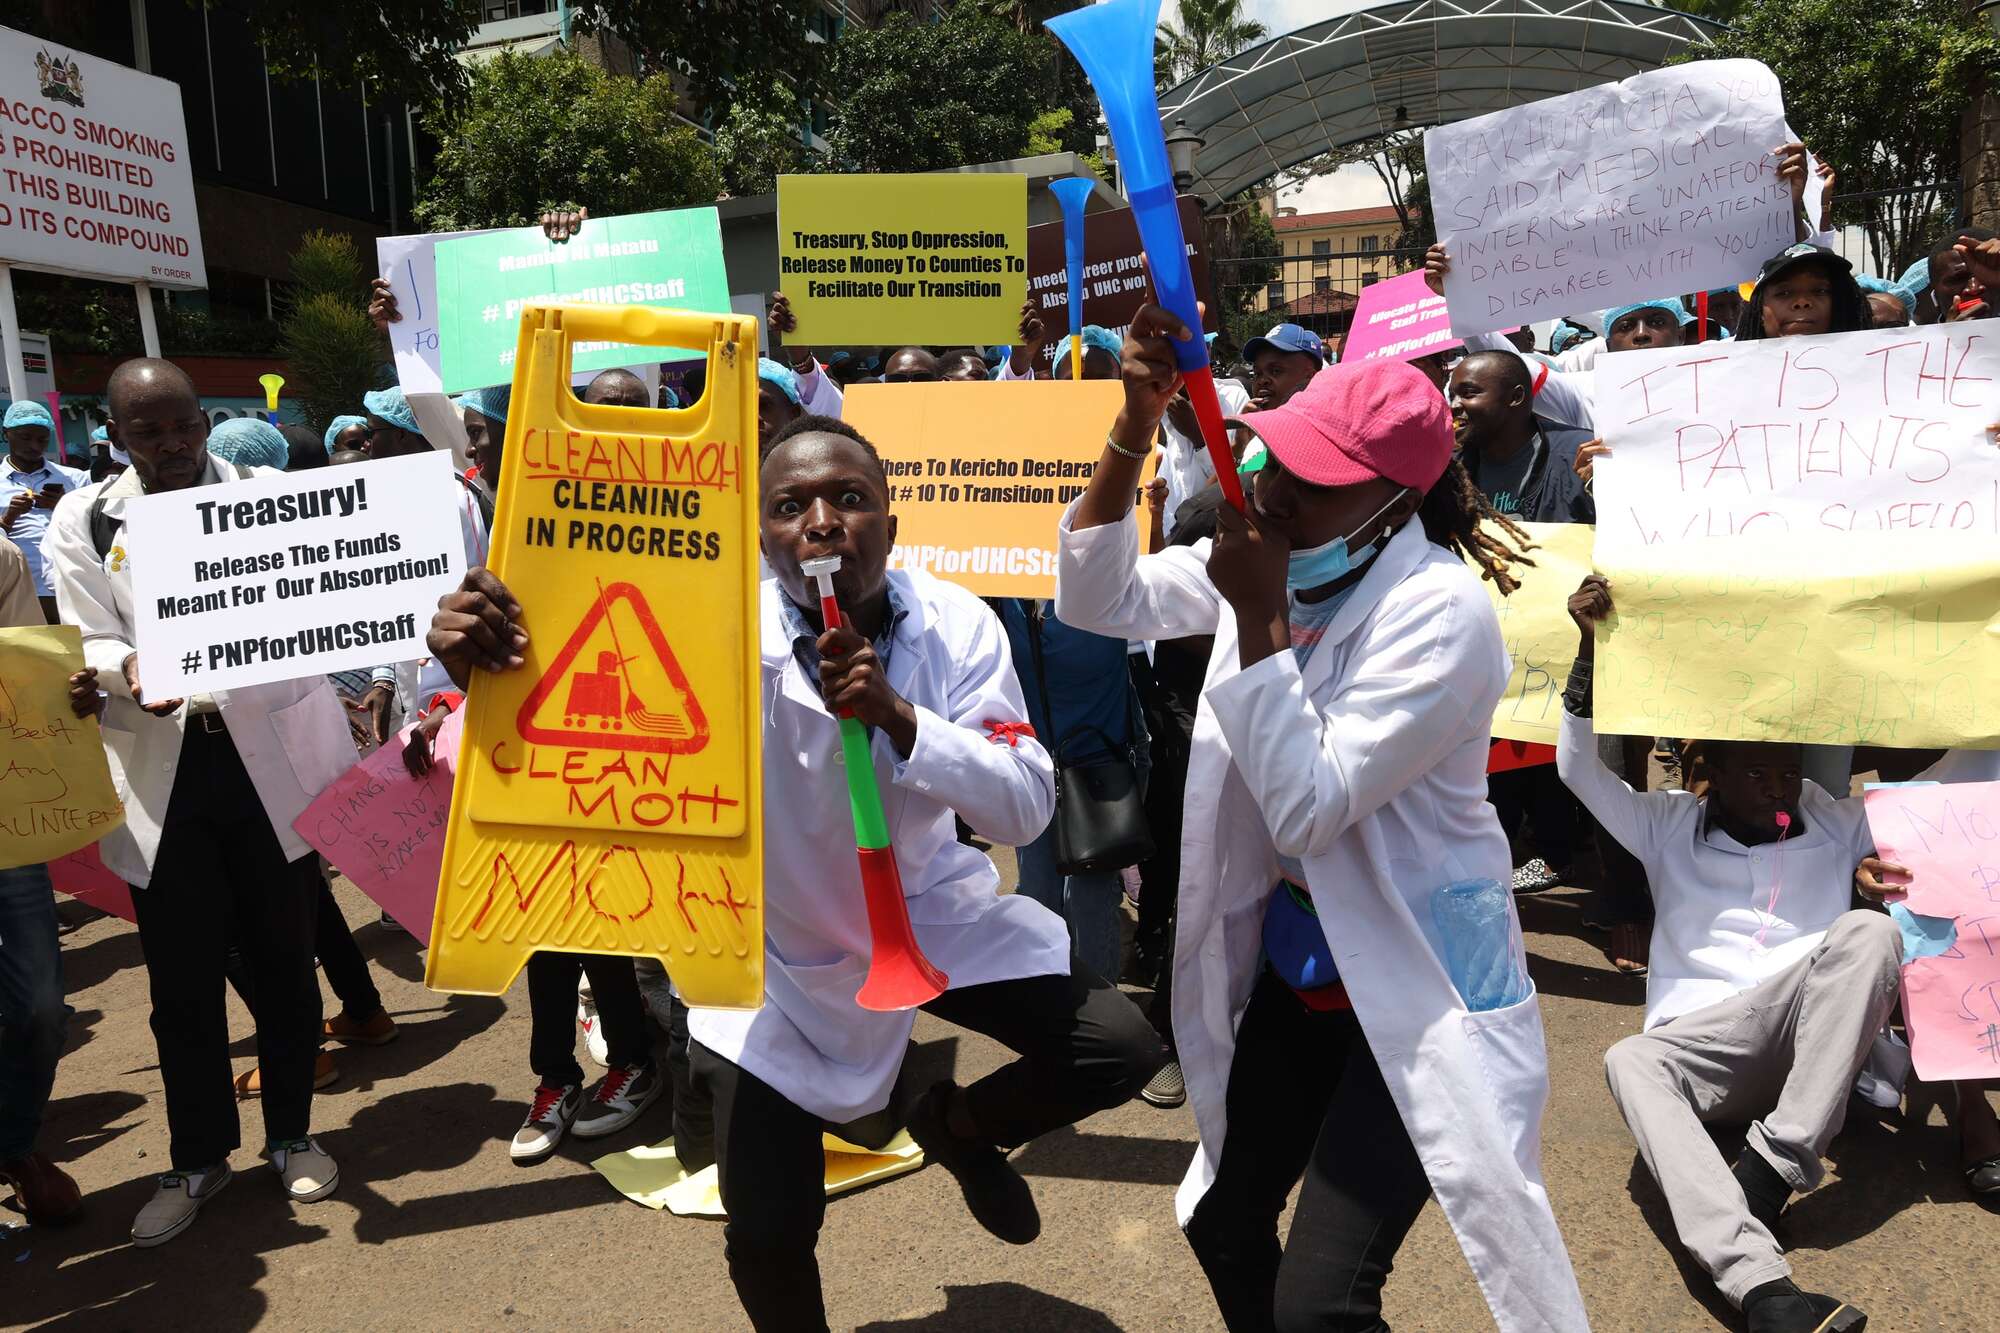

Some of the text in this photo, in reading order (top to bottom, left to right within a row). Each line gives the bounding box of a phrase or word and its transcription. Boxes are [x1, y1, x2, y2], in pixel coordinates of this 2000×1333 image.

[73, 117, 176, 163] SMOKING
[1446, 83, 1703, 179] NAKHUMICHA
[13, 136, 153, 188] PROHIBITED
[1451, 181, 1539, 232] SAID
[1558, 126, 1735, 203] MEDICAL
[3, 168, 171, 224] THIS BUILDING
[1610, 217, 1673, 251] THINK
[1680, 182, 1790, 233] PATIENTS
[20, 207, 57, 235] ITS
[64, 216, 189, 258] COMPOUND
[594, 238, 660, 257] Matatu
[792, 230, 1009, 250] Treasury, Stop Oppression,
[1460, 209, 1586, 265] INTERNS
[1595, 194, 1646, 226] ARE
[151, 265, 192, 280] BY ORDER
[781, 255, 1025, 275] Release Money To Counties To
[808, 279, 1002, 298] Facilitate Our Transition
[1093, 278, 1121, 297] UHC
[1488, 268, 1614, 317] DISAGREE
[1627, 247, 1694, 282] WITH
[1620, 335, 1993, 425] IT IS THE
[522, 427, 741, 495] CLEAN MOH
[926, 458, 947, 477] To
[950, 457, 1016, 478] Kericho
[1675, 413, 1952, 494] PATIENTS
[196, 477, 368, 536] Treasury!
[553, 479, 701, 520] CLEANING
[899, 485, 914, 502] #
[916, 484, 936, 503] 10
[938, 484, 960, 503] To
[963, 484, 1055, 504] Transition
[194, 531, 402, 583] Release The Funds
[525, 516, 721, 562] IN PROGRESS
[156, 553, 450, 620] Meant For Our Absorption!
[181, 613, 416, 676] # PNPforUHCStaff
[490, 741, 673, 788] CLEAN
[568, 783, 740, 827] MOH
[363, 832, 390, 858] IS
[472, 839, 758, 935] MOH
